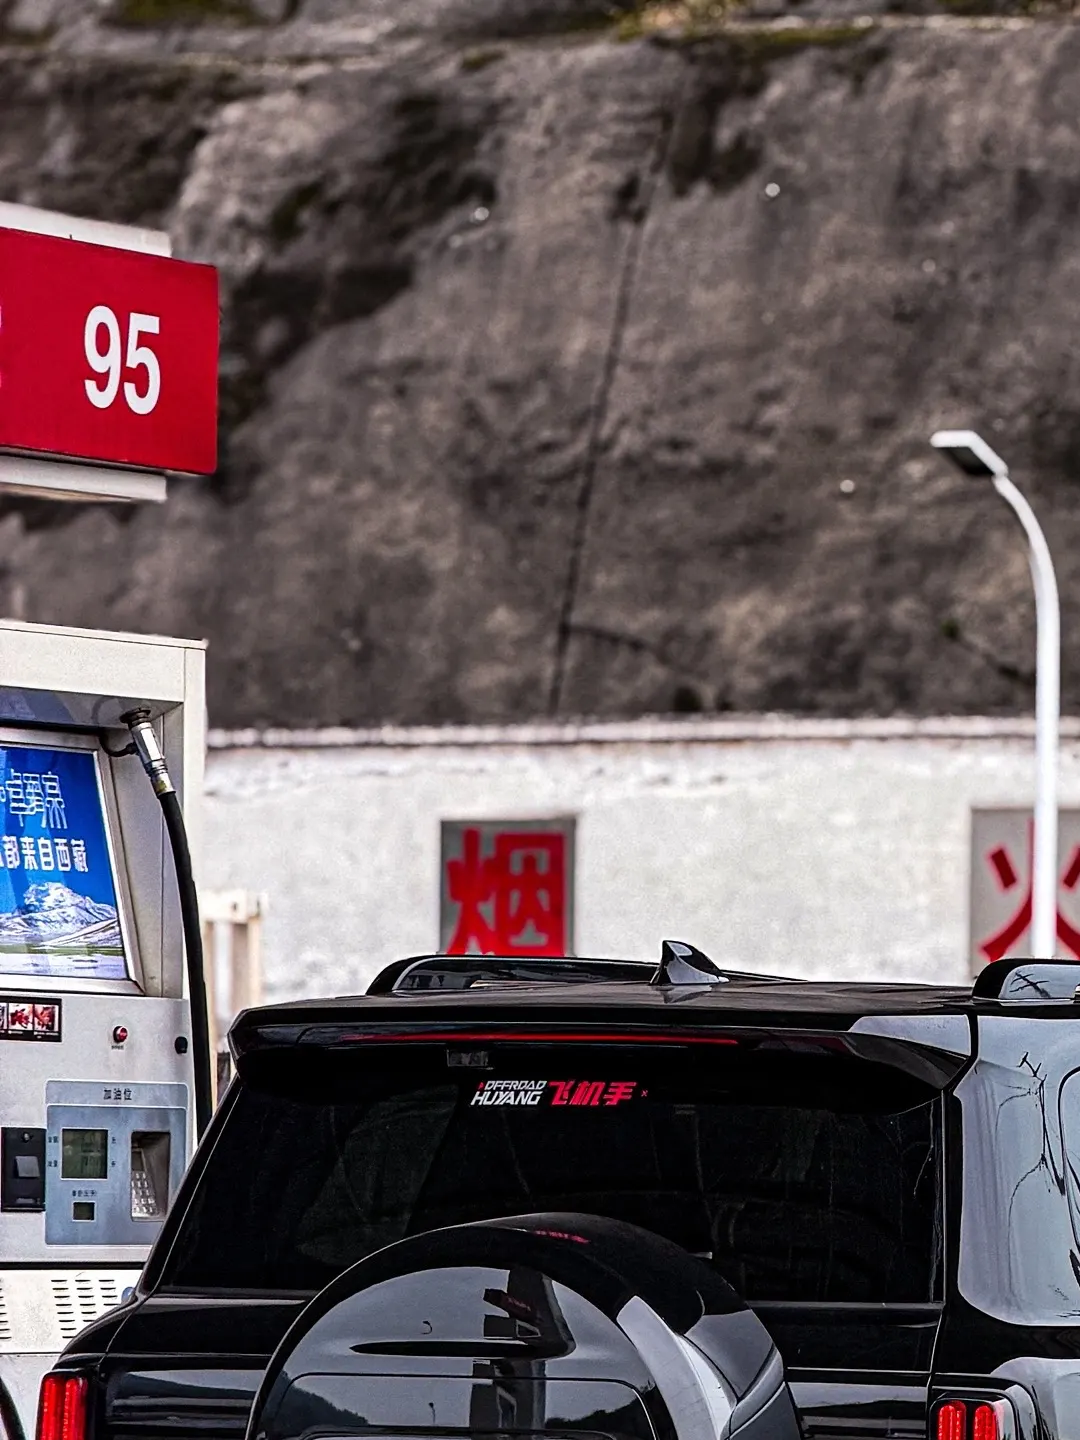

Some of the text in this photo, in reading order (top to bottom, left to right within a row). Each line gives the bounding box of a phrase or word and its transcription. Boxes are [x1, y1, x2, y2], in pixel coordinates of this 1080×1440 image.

[84, 305, 161, 415] 95
[0, 834, 89, 873] 都来自西藏
[446, 826, 567, 958] 烟
[470, 1091, 543, 1106] HUYANG
[484, 1080, 547, 1090] OFFROAD
